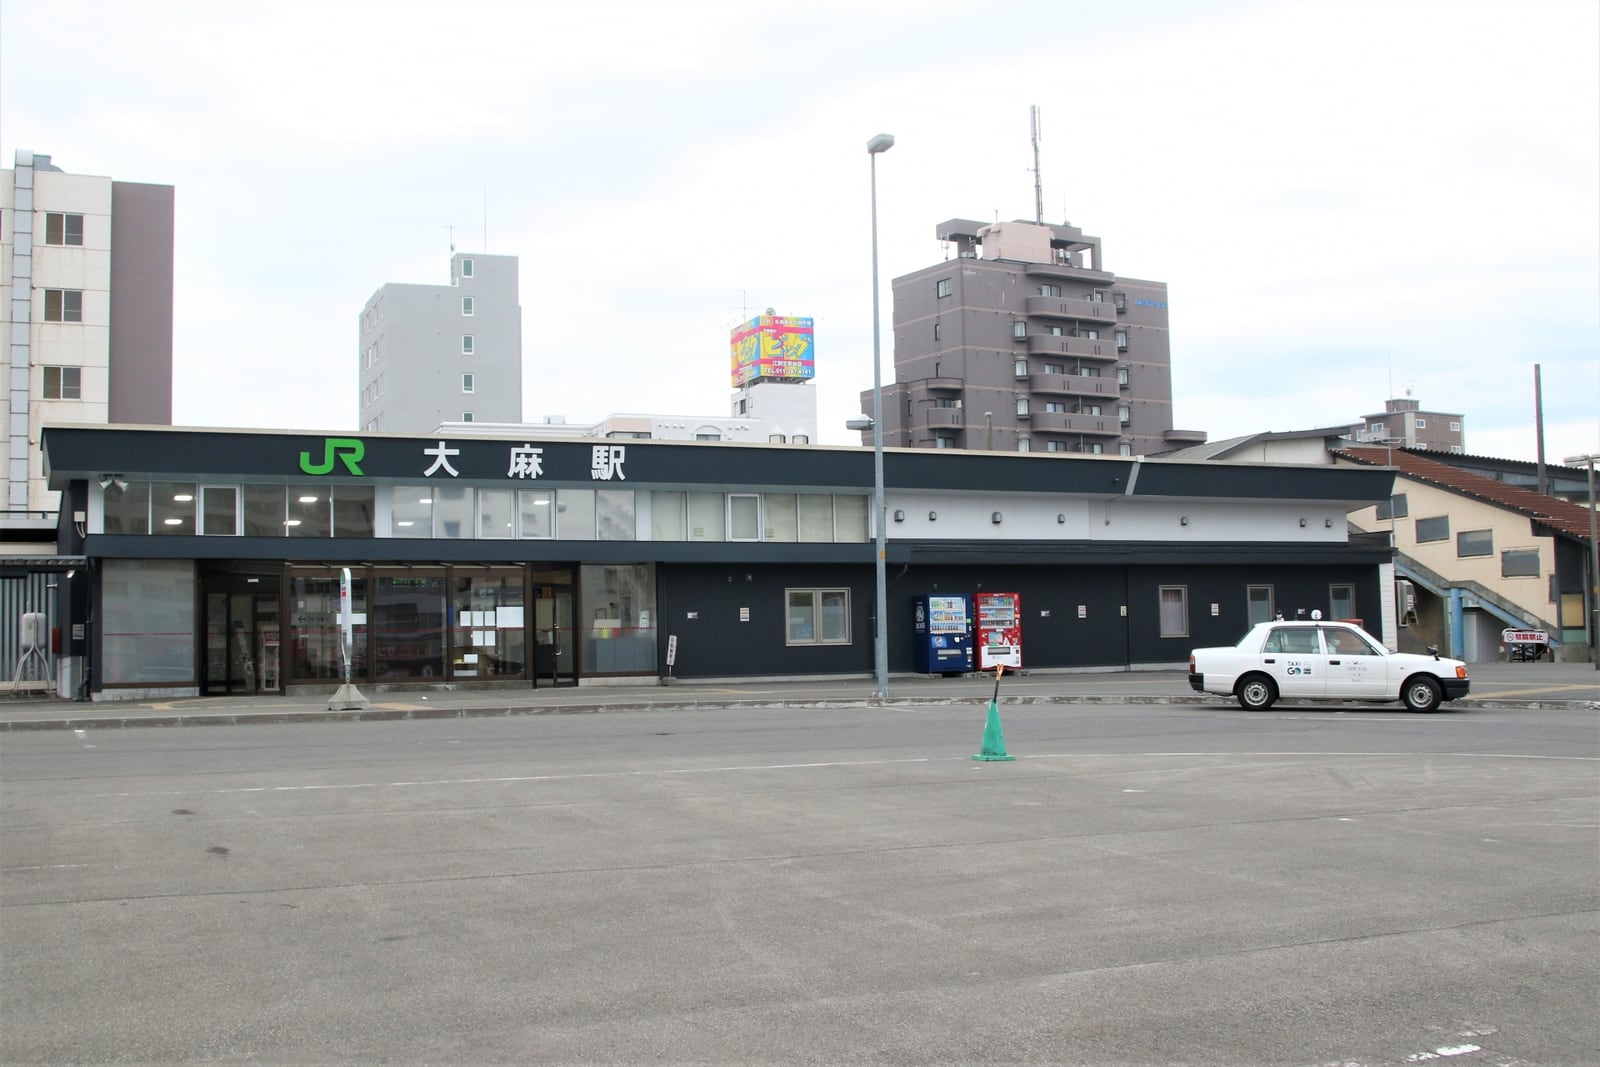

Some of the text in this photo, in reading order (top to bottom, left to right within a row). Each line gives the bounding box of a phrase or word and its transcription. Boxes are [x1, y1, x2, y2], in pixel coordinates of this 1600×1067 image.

[300, 438, 626, 480] JR 大麻駅
[1287, 667, 1301, 675] GO
